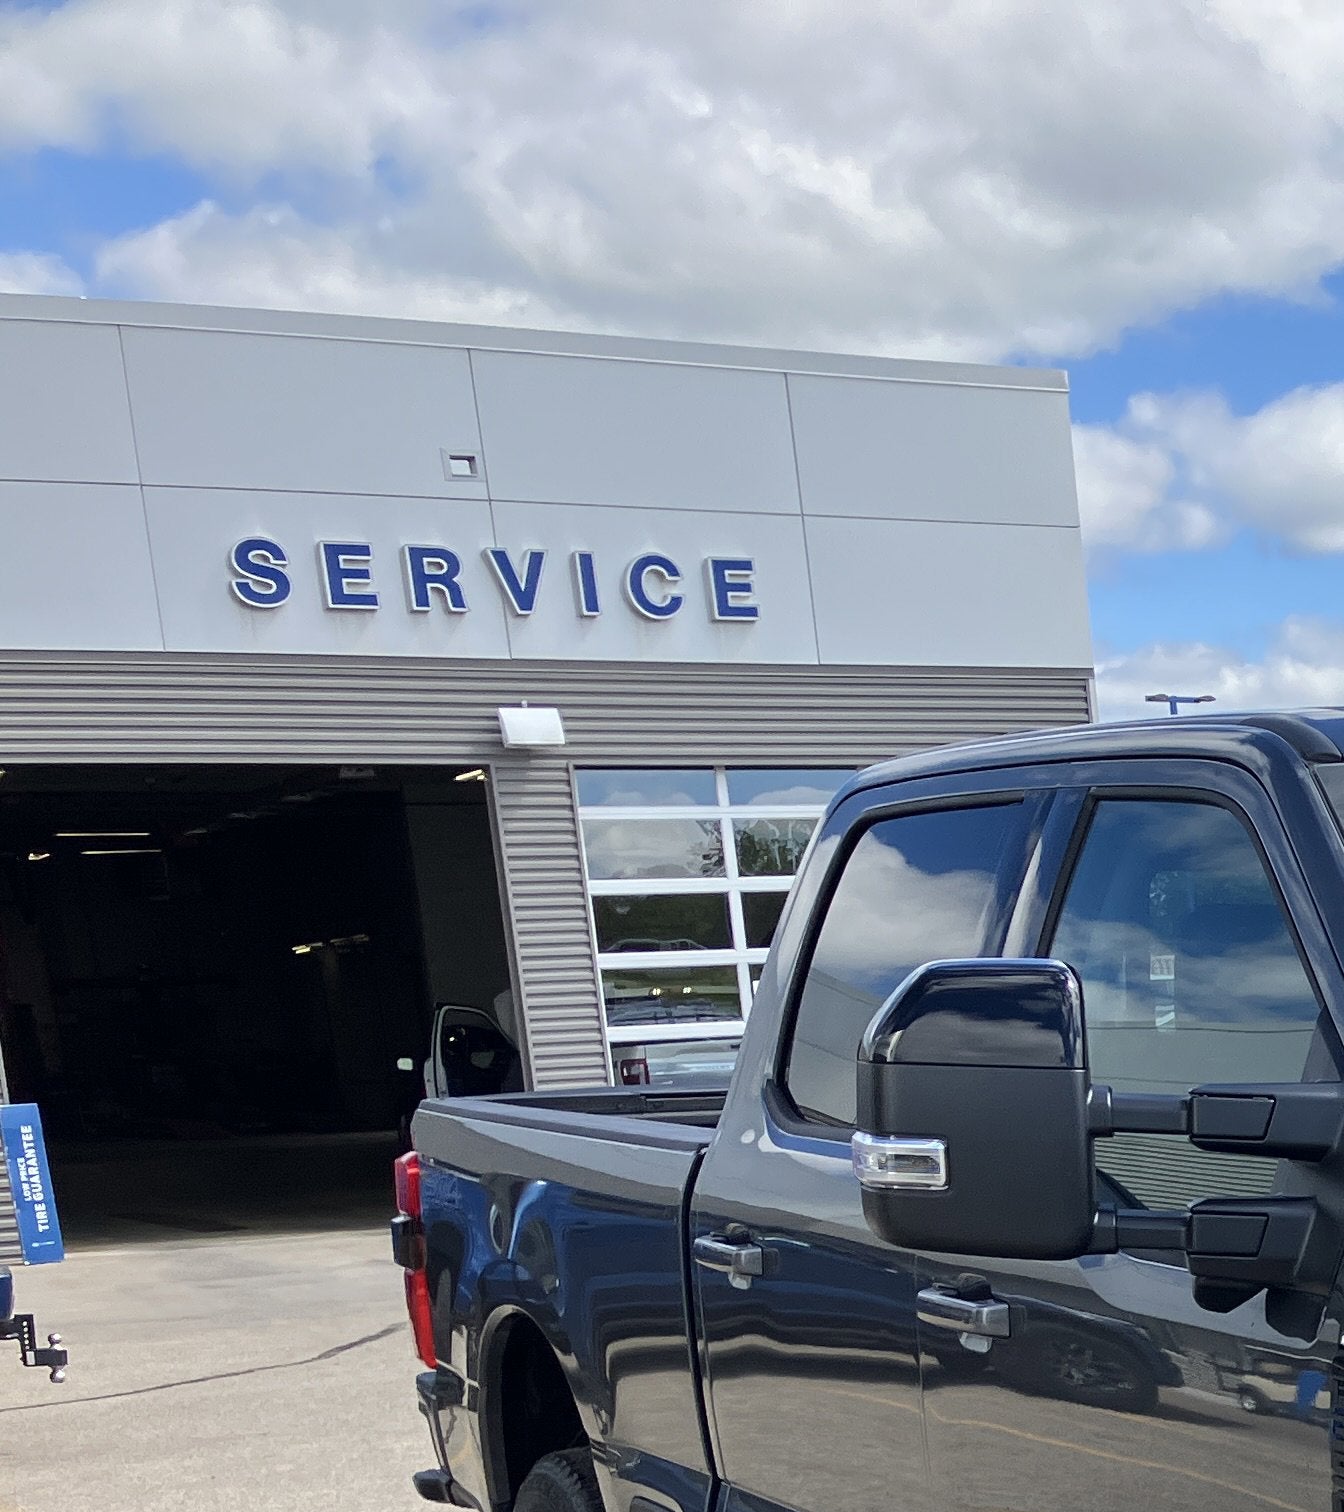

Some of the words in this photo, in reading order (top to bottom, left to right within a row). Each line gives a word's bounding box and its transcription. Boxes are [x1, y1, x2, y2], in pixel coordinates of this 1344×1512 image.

[229, 535, 762, 623] SERVICE
[16, 1156, 30, 1182] PRICE
[21, 1124, 44, 1201] GUARANTEE
[22, 1182, 33, 1202] LOW
[34, 1202, 50, 1232] TIRE
